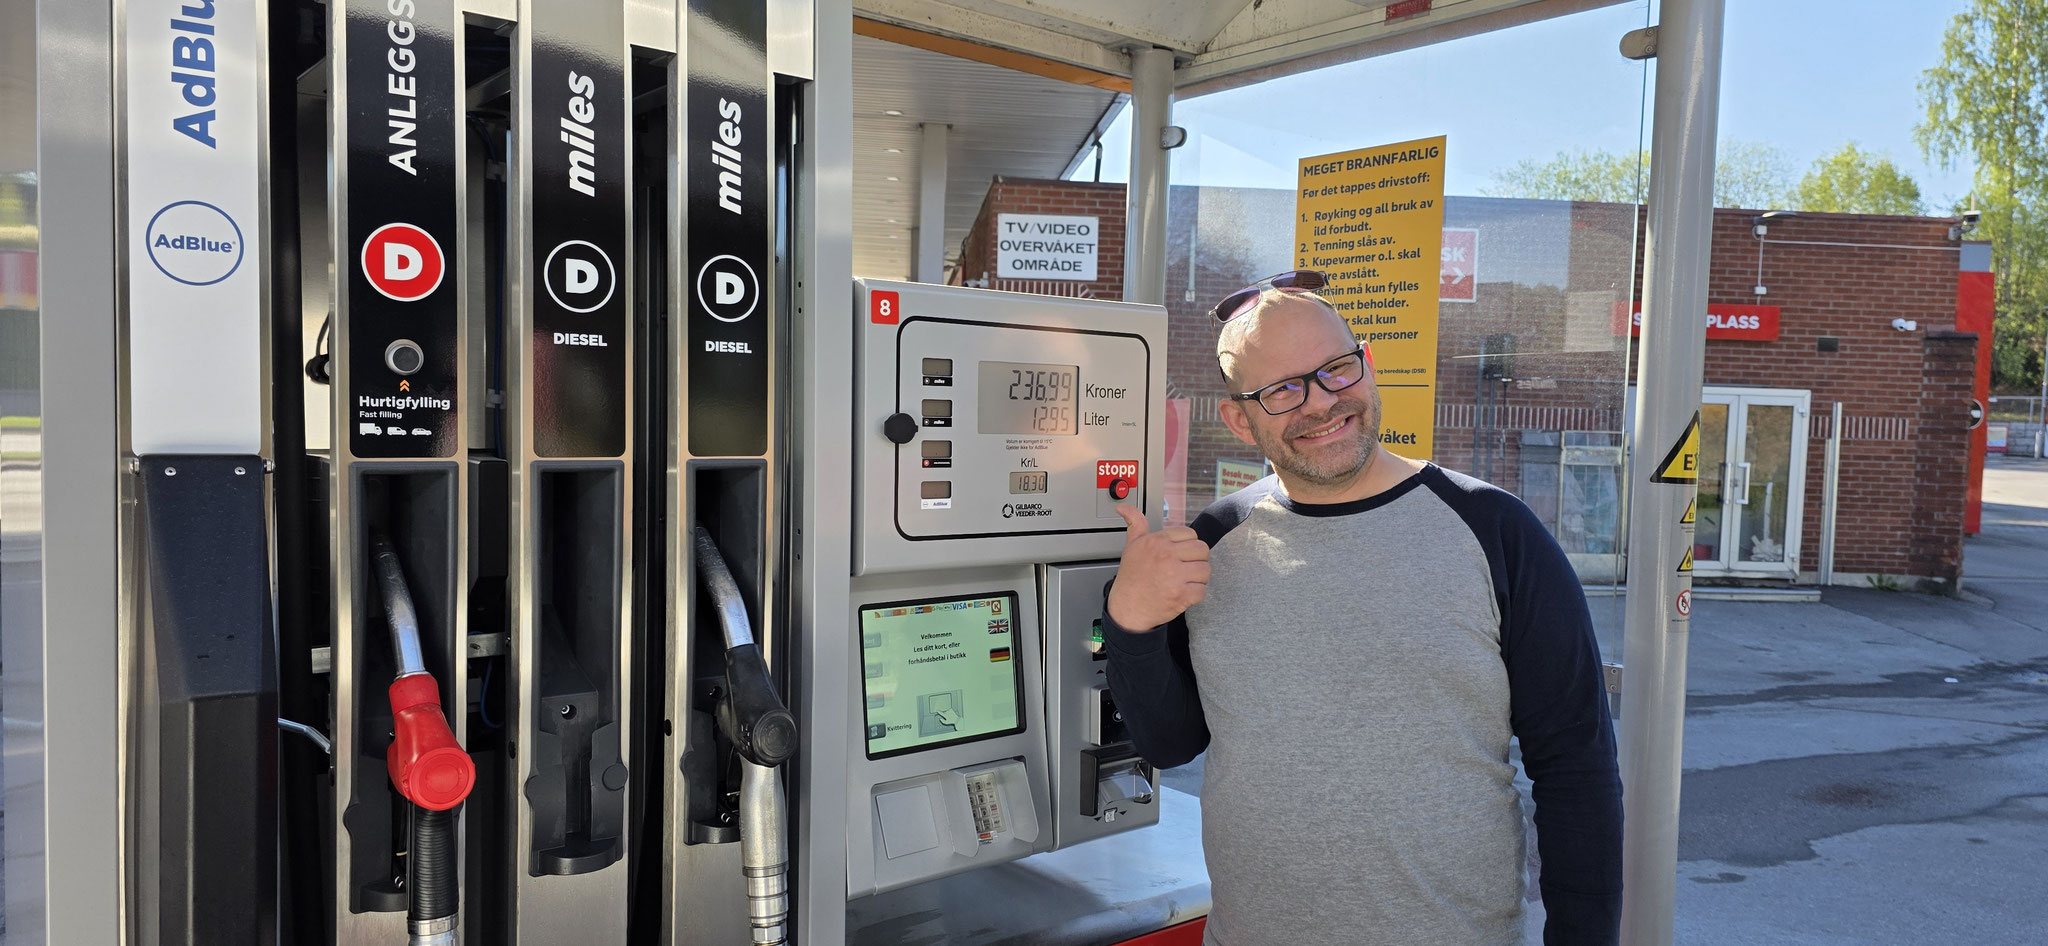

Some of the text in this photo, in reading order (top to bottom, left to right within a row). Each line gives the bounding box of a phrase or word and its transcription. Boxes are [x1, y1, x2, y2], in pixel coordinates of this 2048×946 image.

[387, 0, 417, 175] ANLEGGS
[560, 70, 595, 197] miles
[712, 97, 742, 215] miles
[1303, 146, 1439, 177] MEGET BRANNFARLIG
[1302, 172, 1430, 199] Før det tappes drivstoff:
[1301, 200, 1433, 223] 1. Røyking og all bruk av
[1005, 222, 1090, 236] TV/VIDEO
[1314, 222, 1372, 236] ild forbudt.
[1000, 240, 1095, 254] OVERVÅKET
[1300, 235, 1396, 253] 2. Tenning slås av.
[384, 242, 423, 281] D
[1012, 258, 1082, 272] OMRÅDE
[1299, 248, 1421, 268] 3. Kupevarmer o.l. skal
[566, 258, 599, 294] D
[1340, 267, 1379, 279] avslått.
[716, 271, 745, 305] D
[1347, 283, 1363, 294] må
[1365, 283, 1386, 293] kun
[1388, 281, 1419, 294] fylles
[880, 299, 891, 317] 8
[1357, 299, 1409, 310] beholder.
[1351, 315, 1373, 325] skal
[1376, 315, 1397, 325] kun
[553, 332, 608, 347] DIESEL
[1355, 331, 1419, 342] av personer
[705, 340, 752, 354] DIESEL
[1009, 370, 1072, 403] 236,99
[1085, 383, 1126, 399] Kroner
[360, 396, 451, 410] Hurtigfylling
[379, 411, 403, 419] filling
[1033, 406, 1069, 433] 12,95
[1084, 412, 1110, 426] Liter
[1021, 458, 1038, 468] Kr/L
[1098, 462, 1136, 478] stopp
[1019, 475, 1045, 492] 18,30
[952, 602, 967, 610] VISA
[921, 632, 952, 640] Velkommen
[935, 642, 947, 650] kort,
[908, 655, 946, 665] forhåndsbetal
[950, 652, 967, 660] butikk
[887, 723, 912, 732] Kvittering
